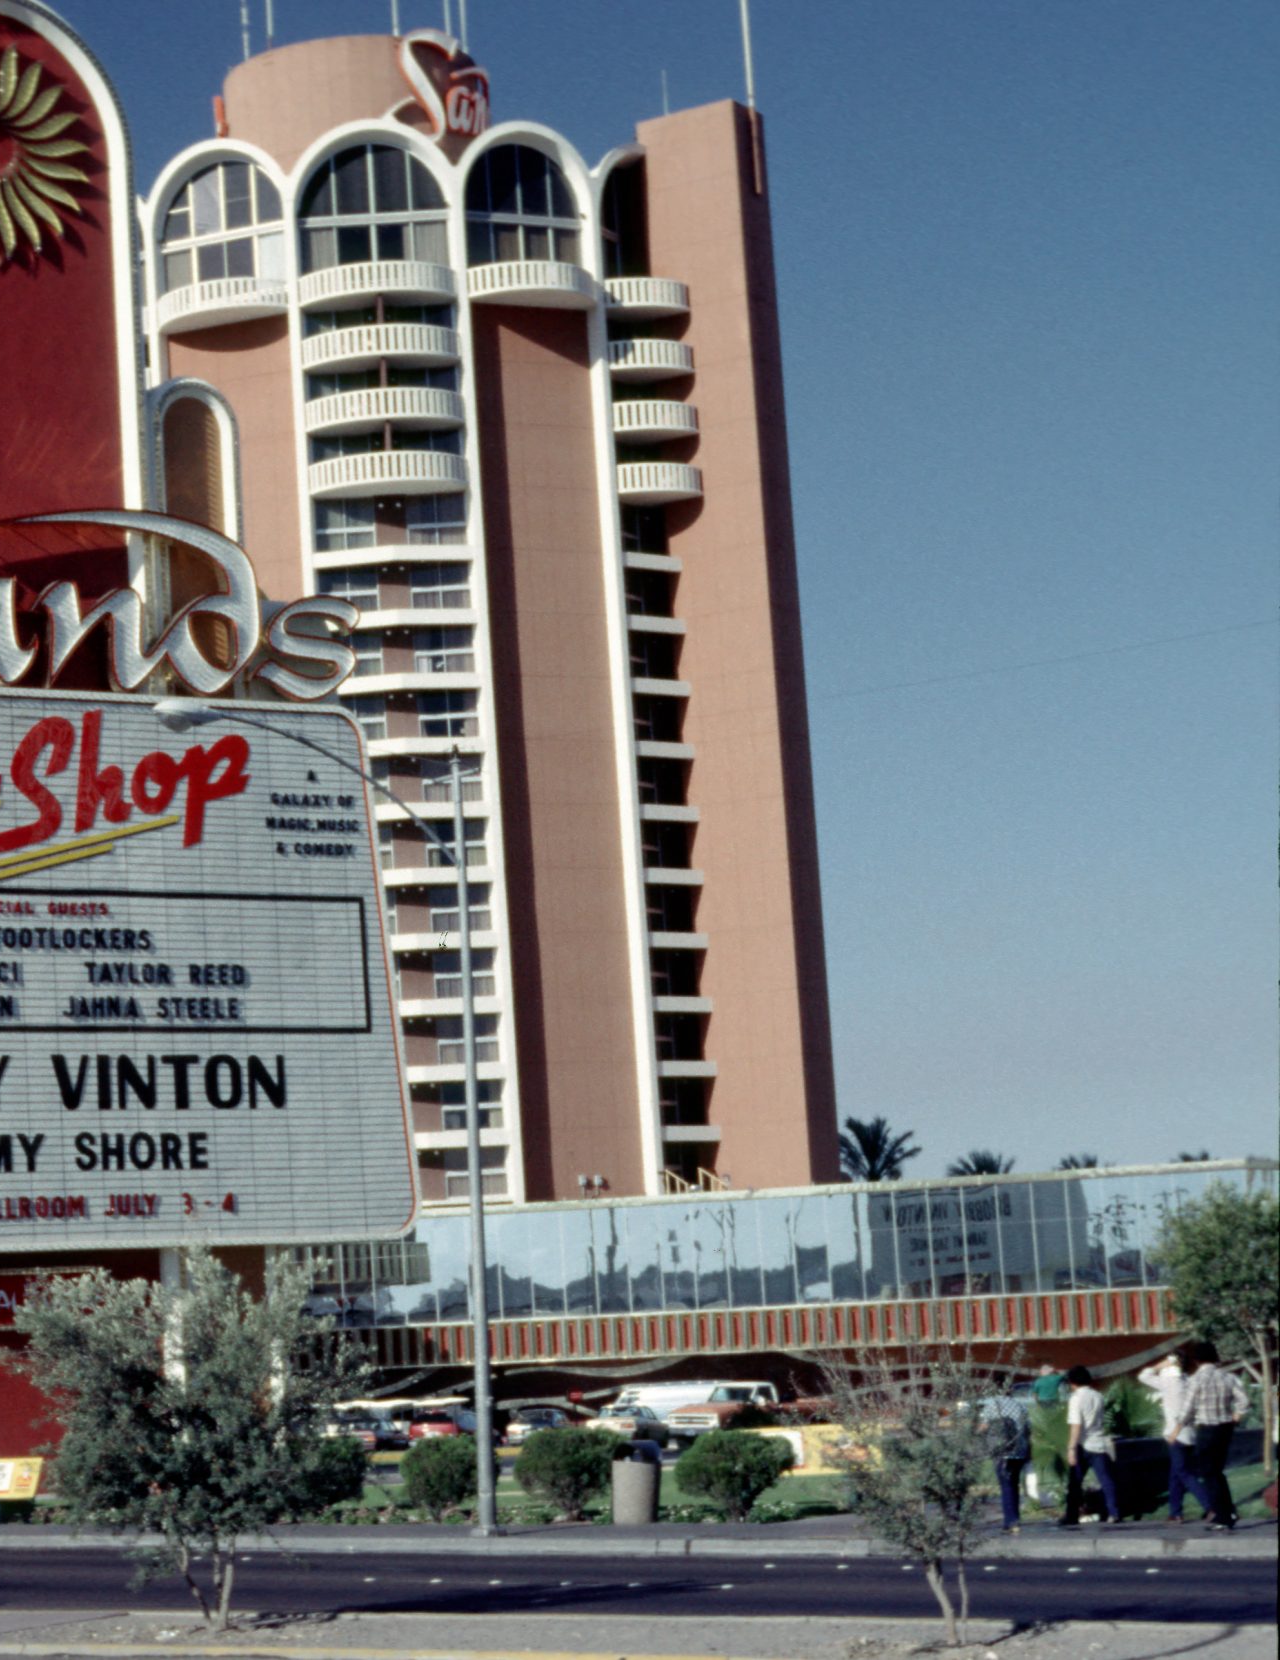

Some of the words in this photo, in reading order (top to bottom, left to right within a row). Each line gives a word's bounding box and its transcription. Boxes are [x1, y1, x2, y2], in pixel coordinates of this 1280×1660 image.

[307, 769, 318, 781] A
[271, 792, 331, 808] GALAXY
[337, 795, 355, 808] OF
[294, 842, 354, 857] COMEDY
[47, 902, 109, 916] GUESTS
[84, 961, 171, 985] TAYLOR
[189, 964, 246, 986] REED
[63, 996, 140, 1018] JAHNA
[157, 997, 239, 1020] STEELE
[51, 1054, 287, 1110] VINTON
[75, 1131, 209, 1172] SHORE
[104, 1193, 157, 1217] JULY
[181, 1192, 194, 1216] 3
[222, 1191, 235, 1214] 4
